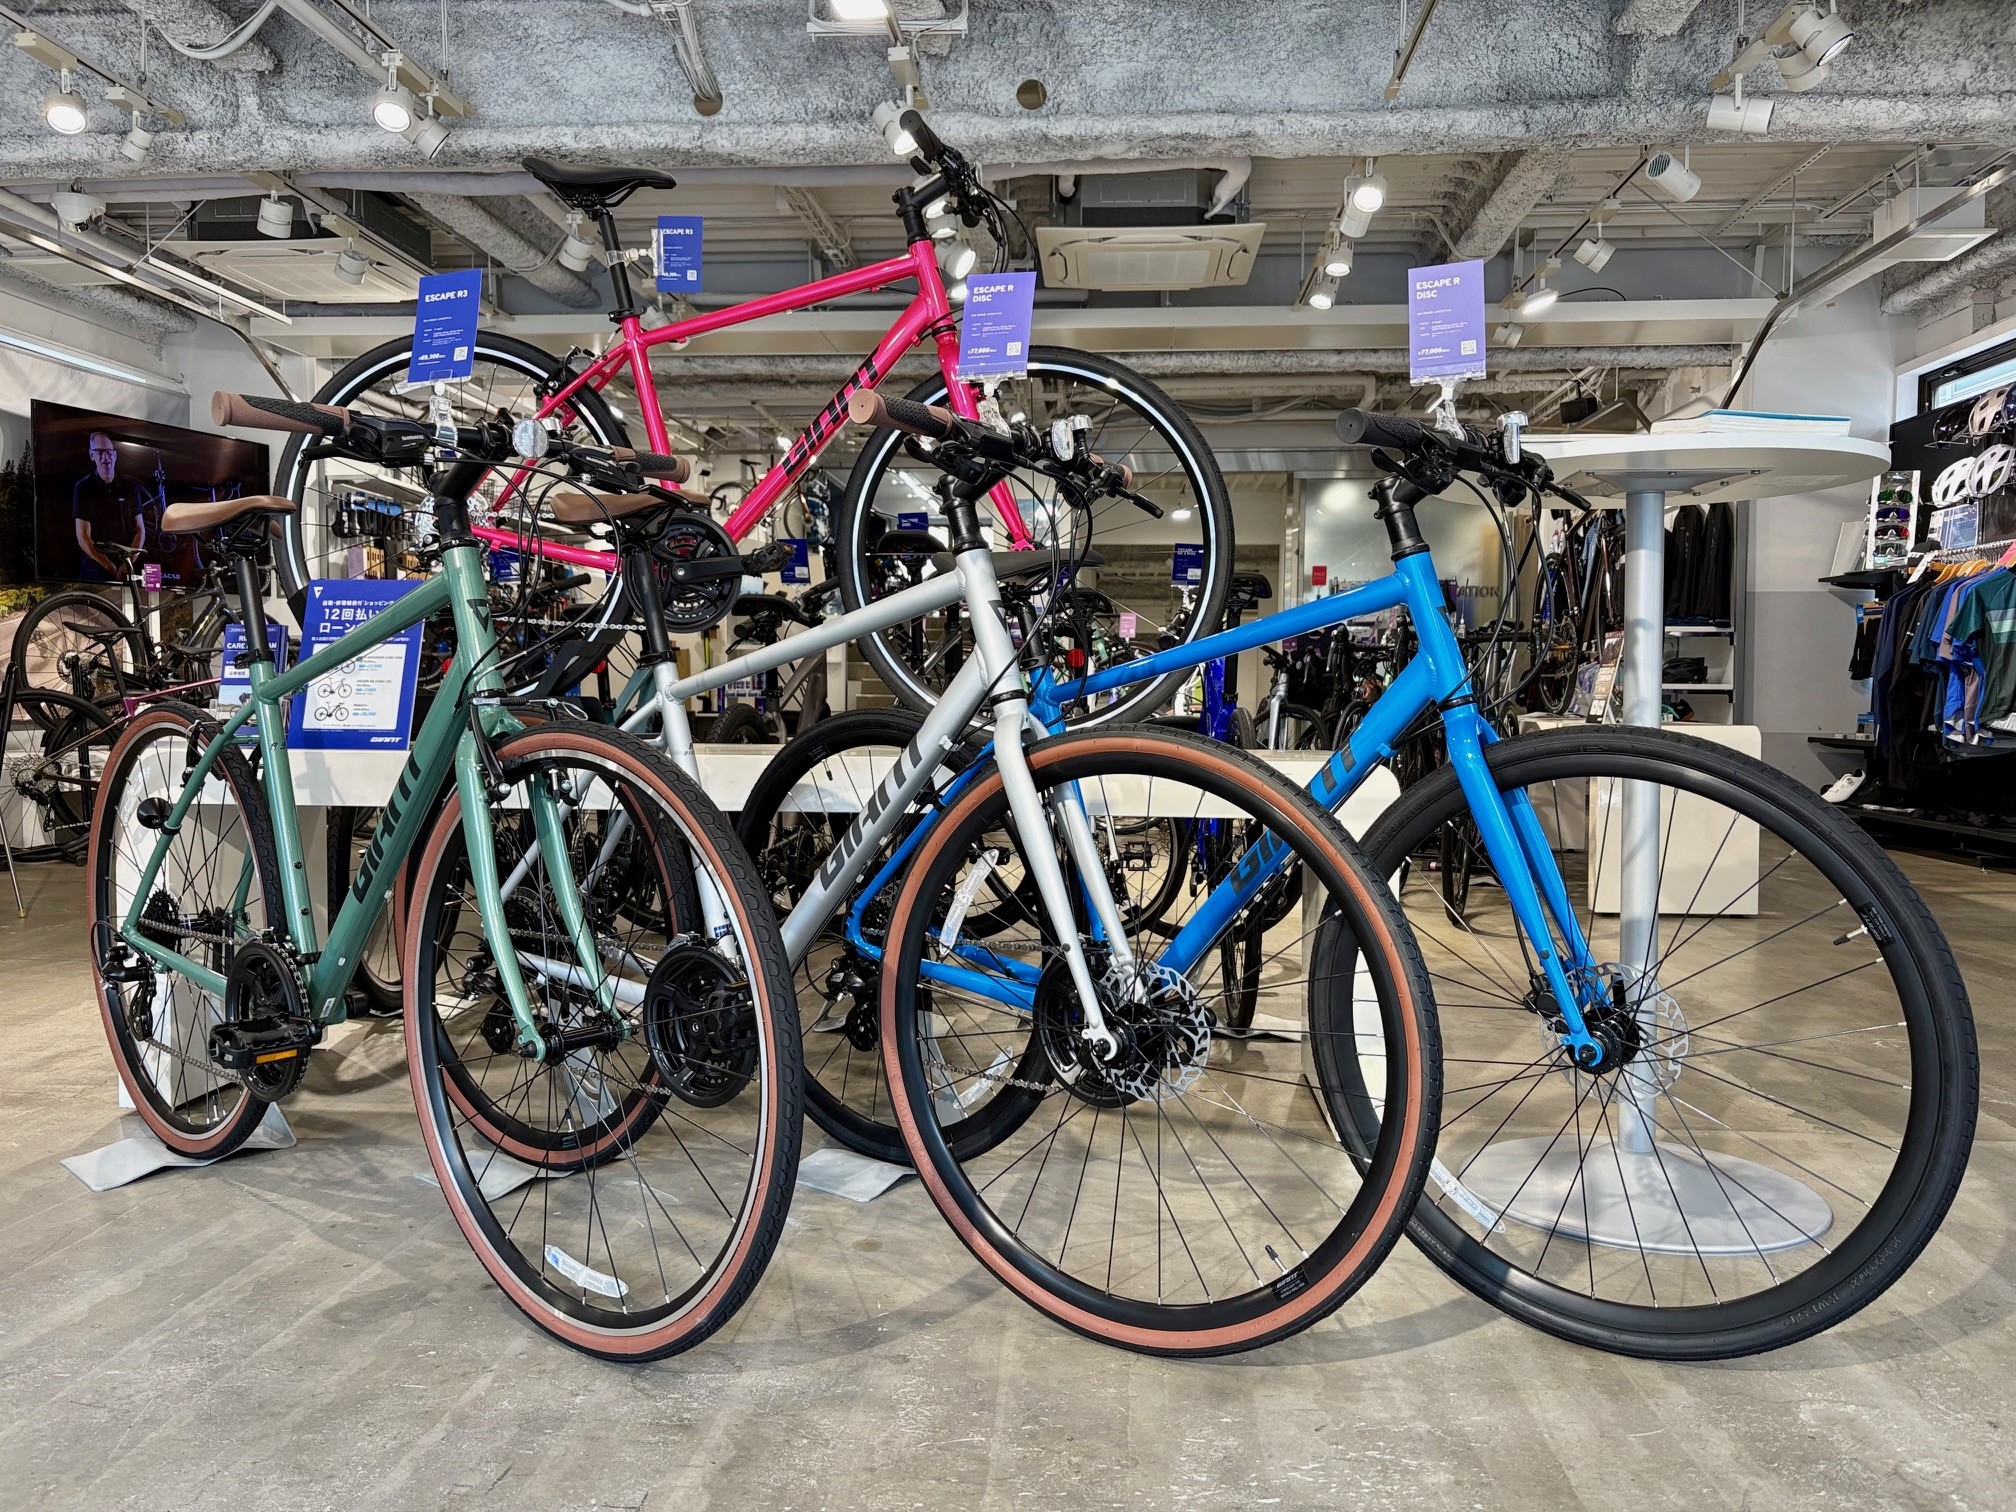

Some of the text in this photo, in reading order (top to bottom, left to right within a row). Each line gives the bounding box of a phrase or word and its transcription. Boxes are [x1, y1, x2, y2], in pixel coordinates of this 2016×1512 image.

[973, 285, 1006, 294] ESCAPE
[1416, 277, 1461, 290] ESCAPE R
[425, 289, 468, 303] ESCAPE R3
[972, 294, 993, 303] DISC
[1416, 290, 1438, 300] DISC
[782, 343, 881, 478] GIANT
[820, 734, 922, 891] GIANT
[353, 754, 421, 904] GIANT
